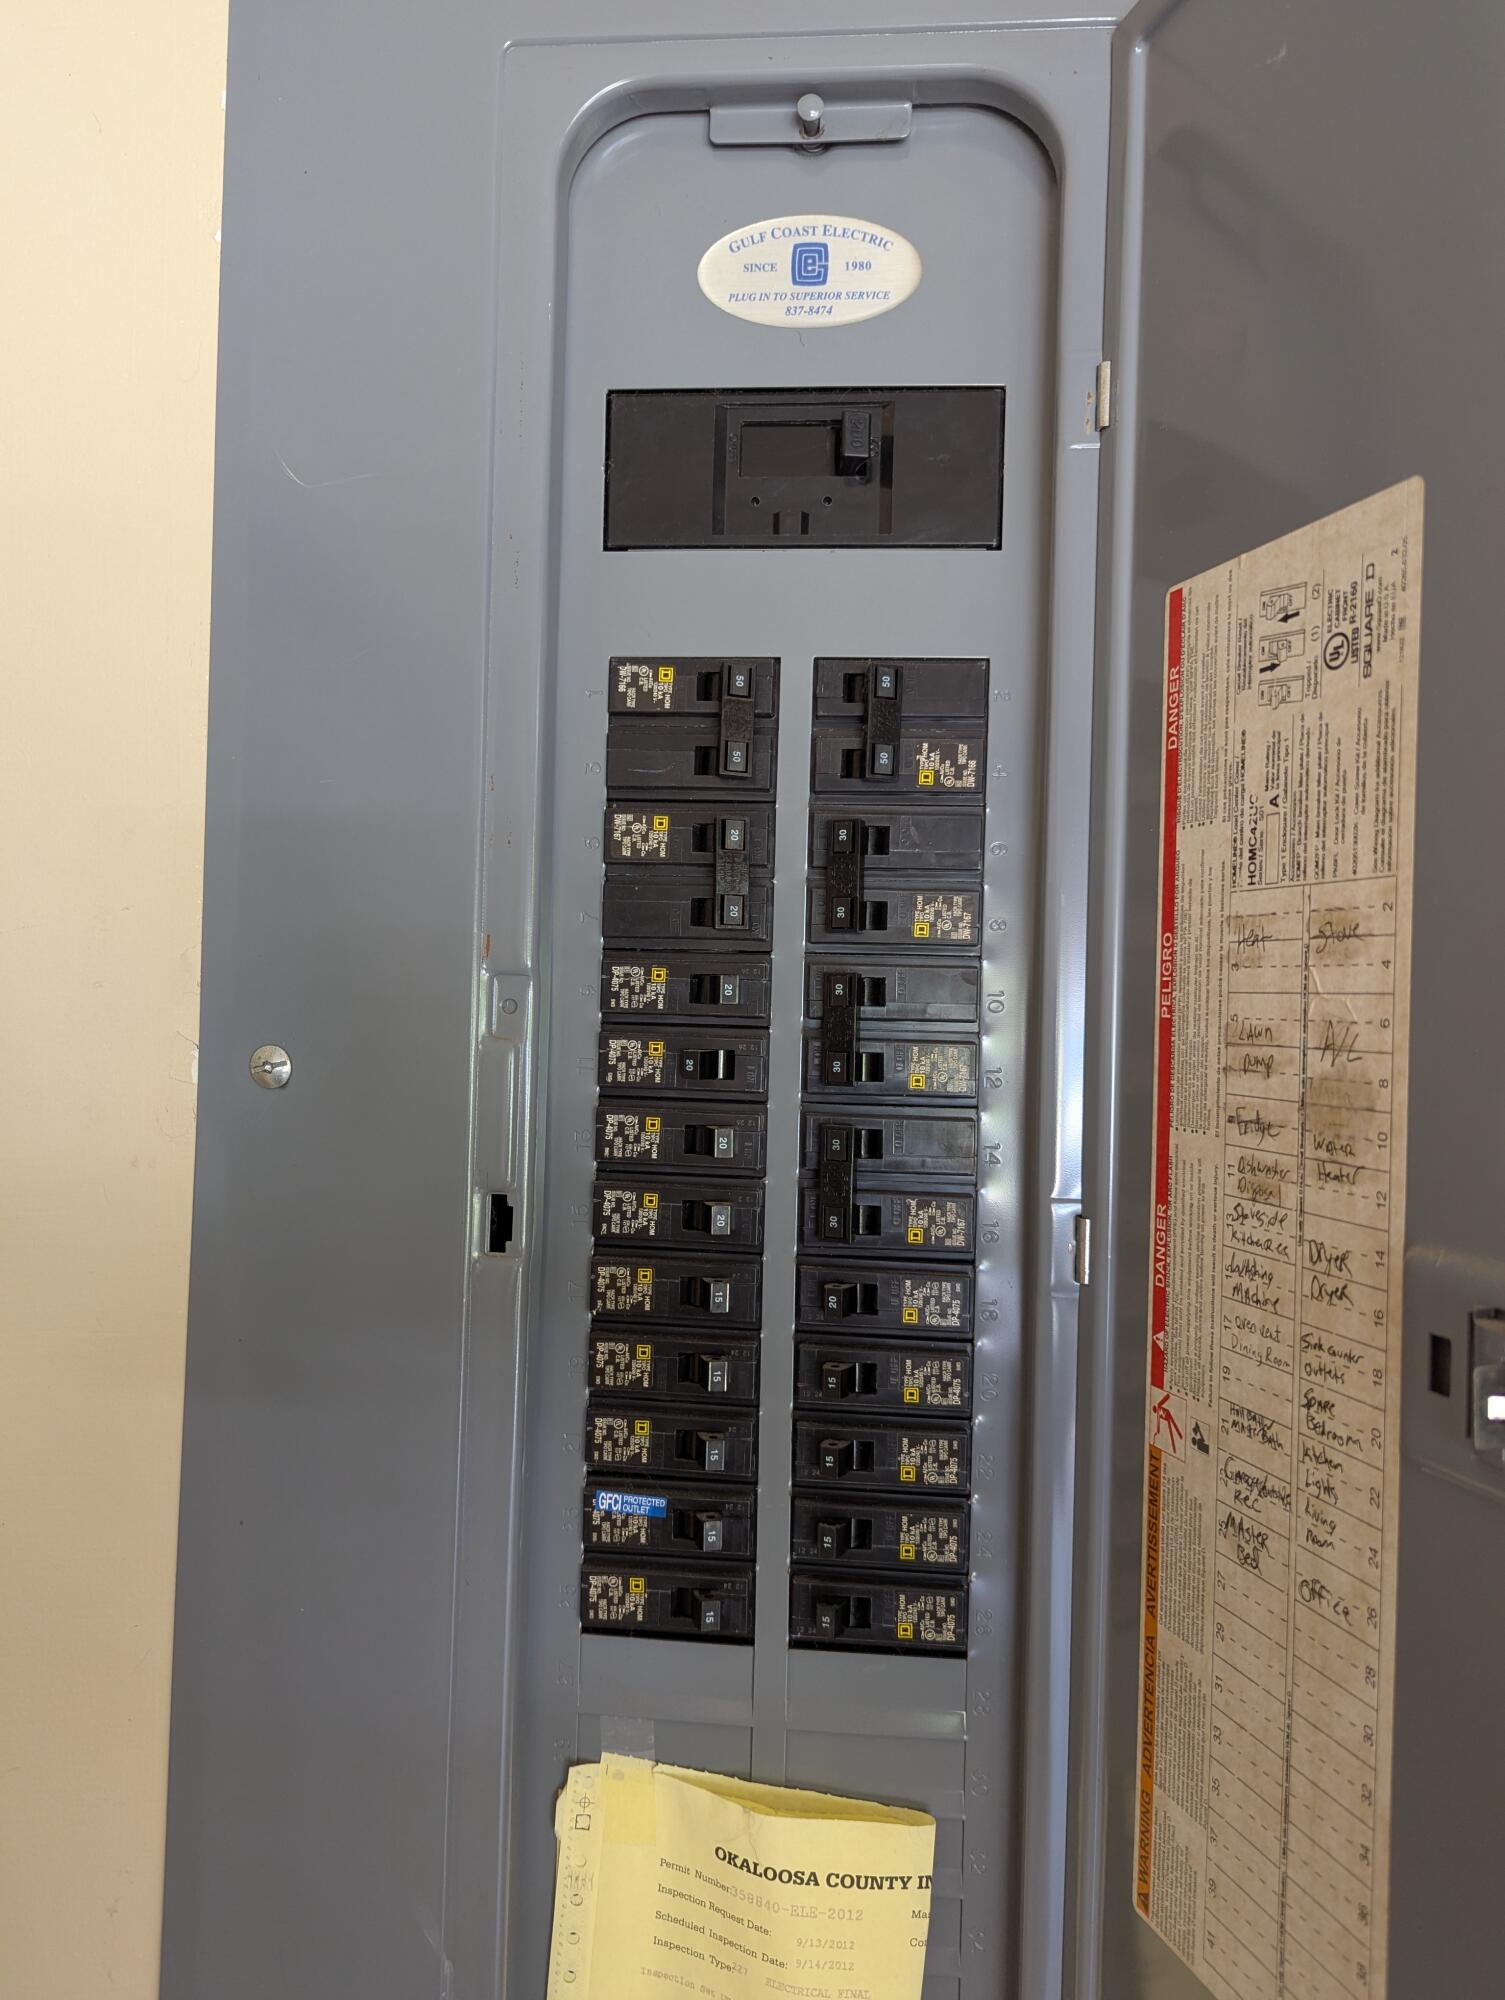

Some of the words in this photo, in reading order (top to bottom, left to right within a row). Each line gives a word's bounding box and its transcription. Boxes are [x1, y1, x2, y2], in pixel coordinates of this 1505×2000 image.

[729, 231, 767, 254] GULF
[770, 226, 819, 240] COAST
[822, 224, 894, 251] ELECTRIC
[743, 262, 778, 273] SINCE
[844, 261, 872, 271] 1980
[728, 293, 757, 303] PLUG
[758, 292, 771, 301] IN
[773, 292, 787, 301] TO
[789, 291, 842, 301] SUPERIOR
[844, 290, 891, 300] SERVICE
[785, 306, 833, 316] 837-8474
[1366, 562, 1375, 580] D
[1312, 583, 1321, 600] (2)
[1350, 581, 1359, 624] R-2160
[1311, 626, 1320, 642] (1)
[1363, 589, 1375, 679] SQUARE
[1329, 639, 1345, 663] UL
[1350, 627, 1360, 664] LISTED
[735, 675, 744, 687] 50
[882, 675, 890, 688] 50
[1168, 665, 1180, 750] DANGER
[733, 751, 742, 763] 50
[880, 752, 888, 764] 50
[1269, 794, 1280, 808] A
[731, 829, 739, 841] 20
[839, 829, 847, 841] 30
[1248, 794, 1258, 886] HOMC42UC
[730, 905, 738, 917] 20
[837, 907, 845, 918] 30
[1383, 902, 1393, 912] 2
[1231, 963, 1240, 971] 3
[1382, 960, 1391, 969] 4
[1161, 932, 1173, 1019] PELIGRO
[724, 984, 733, 996] 20
[835, 984, 843, 996] 30
[987, 990, 1005, 1014] 10
[1230, 1013, 1238, 1022] 5
[1380, 1018, 1390, 1028] 6
[685, 1059, 693, 1071] 20
[833, 1061, 841, 1073] 30
[983, 1067, 1002, 1089] 12
[1379, 1079, 1388, 1089] 8
[719, 1137, 727, 1150] 20
[832, 1139, 840, 1151] 30
[1377, 1132, 1388, 1150] 10
[984, 1143, 1001, 1167] 14
[1227, 1164, 1235, 1177] 11
[1376, 1191, 1387, 1208] 12
[716, 1215, 725, 1227] 20
[829, 1215, 838, 1227] 30
[981, 1221, 1000, 1244] 16
[1155, 1204, 1167, 1287] DANGER
[1375, 1250, 1385, 1268] 14
[715, 1291, 723, 1302] 15
[828, 1296, 837, 1309] 20
[980, 1299, 999, 1323] 18
[1373, 1309, 1384, 1327] 16
[1224, 1315, 1233, 1330] 17
[1232, 1333, 1263, 1366] Dining
[1266, 1347, 1291, 1368] Room
[713, 1370, 721, 1382] 15
[1222, 1365, 1231, 1382] 19
[1372, 1368, 1383, 1387] 18
[828, 1377, 836, 1388] 15
[980, 1375, 999, 1400] 20
[1221, 1418, 1230, 1436] 21
[1371, 1428, 1382, 1450] 20
[710, 1450, 719, 1461] 15
[825, 1456, 834, 1468] 15
[599, 1493, 622, 1510] GFCI
[623, 1495, 666, 1508] PROTECTED
[1369, 1487, 1380, 1510] 22
[622, 1504, 650, 1515] OUTLET
[708, 1530, 716, 1542] 15
[1146, 1454, 1160, 1618] AVERTISSEMENT
[1218, 1520, 1227, 1539] 25
[823, 1536, 832, 1548] 15
[1368, 1547, 1379, 1569] 24
[1217, 1571, 1226, 1591] 27
[705, 1611, 714, 1623] 15
[821, 1616, 830, 1628] 15
[1367, 1606, 1377, 1629] 26
[1216, 1622, 1225, 1642] 29
[1214, 1675, 1223, 1693] 31
[1364, 1666, 1376, 1689] 28
[1143, 1636, 1156, 1778] ADVERTENCIA
[1213, 1725, 1222, 1744] 33
[1363, 1725, 1374, 1747] 30
[1211, 1778, 1220, 1796] 35
[1139, 1790, 1152, 1884] WARNING
[1210, 1828, 1219, 1846] 37
[660, 1857, 691, 1876] Permit
[714, 1846, 820, 1887] OKALOOSA
[826, 1872, 913, 1890] COUNTY
[1208, 1878, 1217, 1898] 39
[657, 1883, 706, 1908] Inspection
[708, 1901, 745, 1926] Request
[747, 1919, 772, 1937] Date:
[796, 1937, 855, 1951] 9/13/2012
[655, 1910, 705, 1935] Scheduled
[708, 1928, 758, 1959] Inspection
[761, 1952, 788, 1970] Date:
[795, 1959, 855, 1972] 9/14/2012
[653, 1935, 705, 1961] Inspection
[709, 1954, 735, 1975] Type:
[764, 1977, 832, 1999] ELECTRICAL
[838, 1989, 872, 2000] FINAL
[640, 1966, 696, 1990] Inspection
